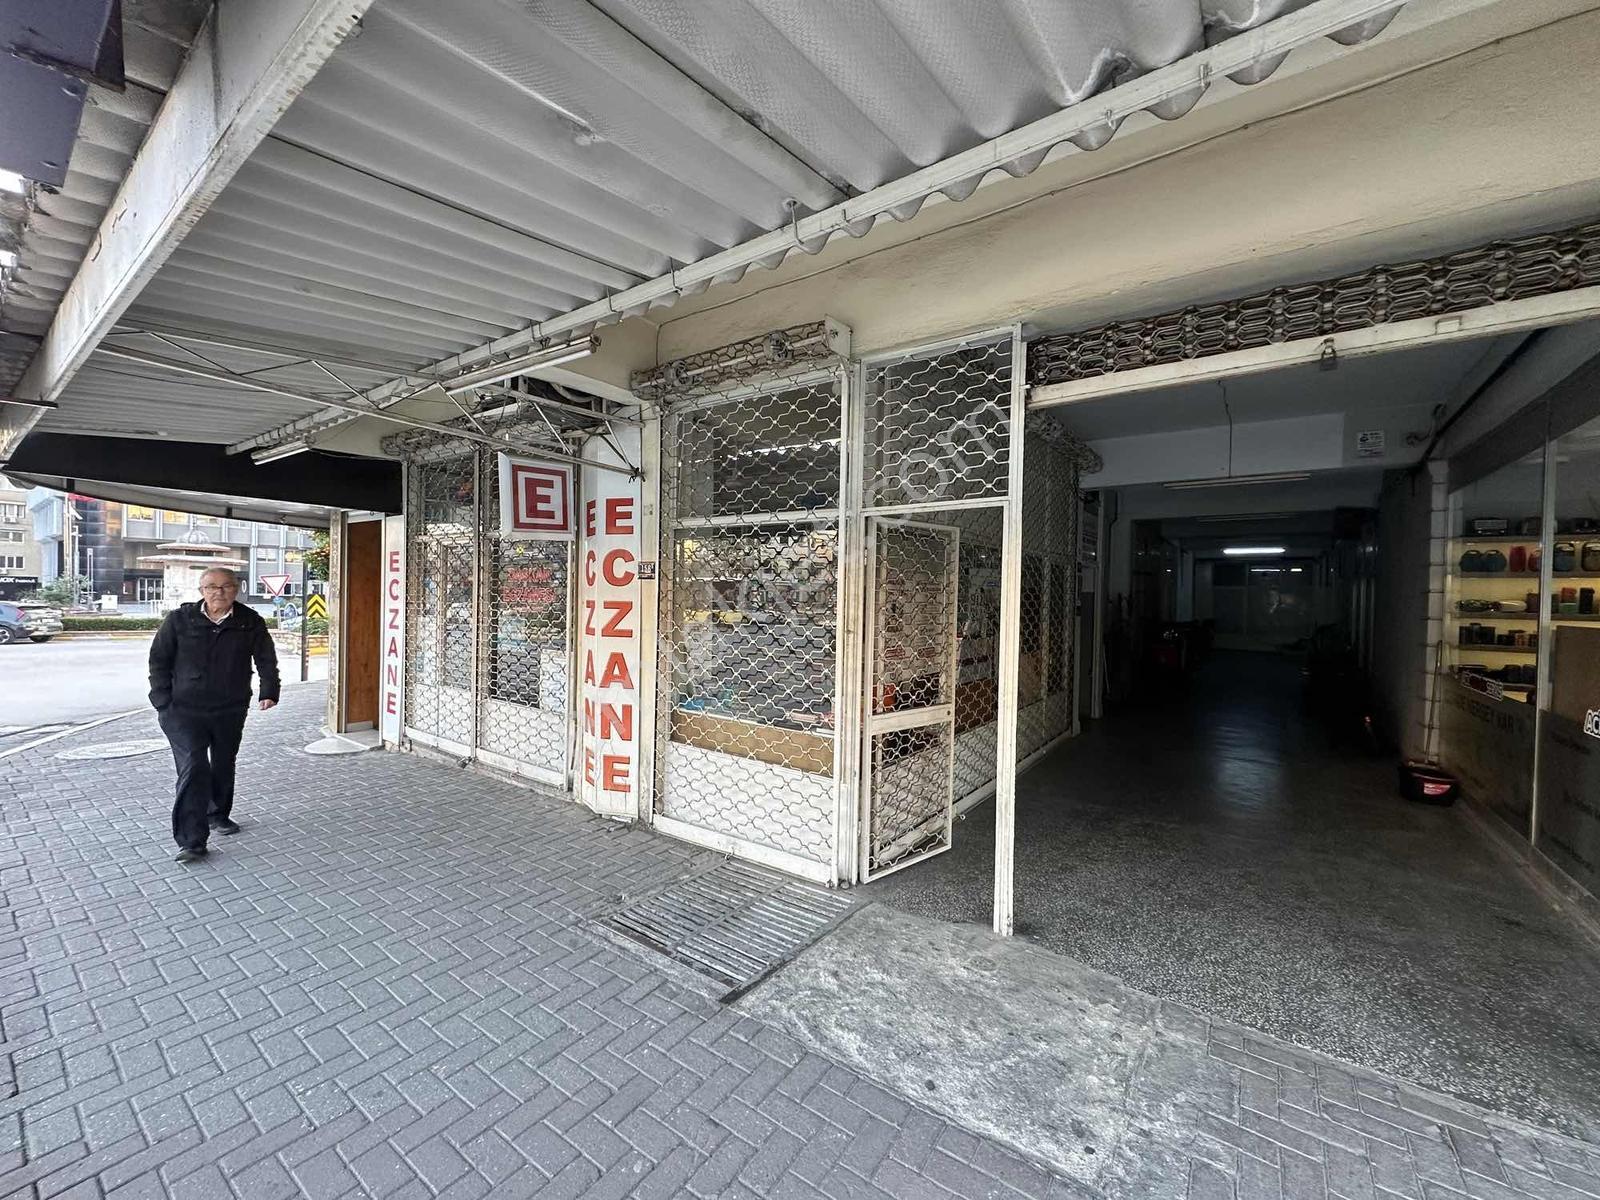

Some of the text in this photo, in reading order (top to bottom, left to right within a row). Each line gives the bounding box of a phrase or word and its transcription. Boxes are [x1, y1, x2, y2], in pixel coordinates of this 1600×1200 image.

[524, 477, 556, 520] E
[386, 551, 401, 714] ECZANE
[584, 499, 596, 786] ECZANE
[599, 497, 635, 792] ECZANE
